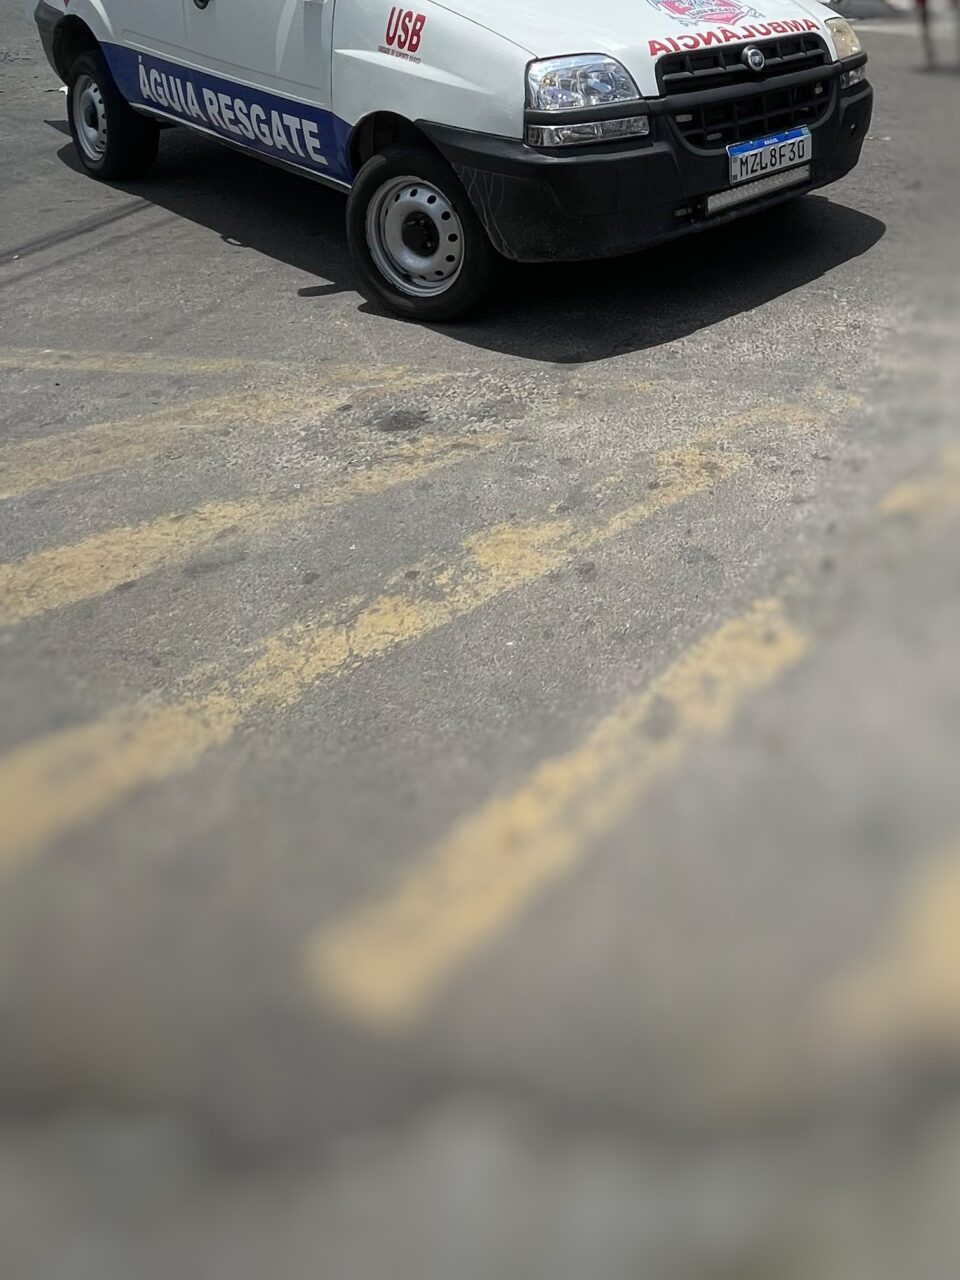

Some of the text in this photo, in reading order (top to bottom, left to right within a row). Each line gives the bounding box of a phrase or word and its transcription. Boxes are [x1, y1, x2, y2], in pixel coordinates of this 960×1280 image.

[385, 6, 426, 53] USB
[138, 55, 329, 166] ÁGUIA RESGATE
[740, 139, 805, 177] MZL8F30
